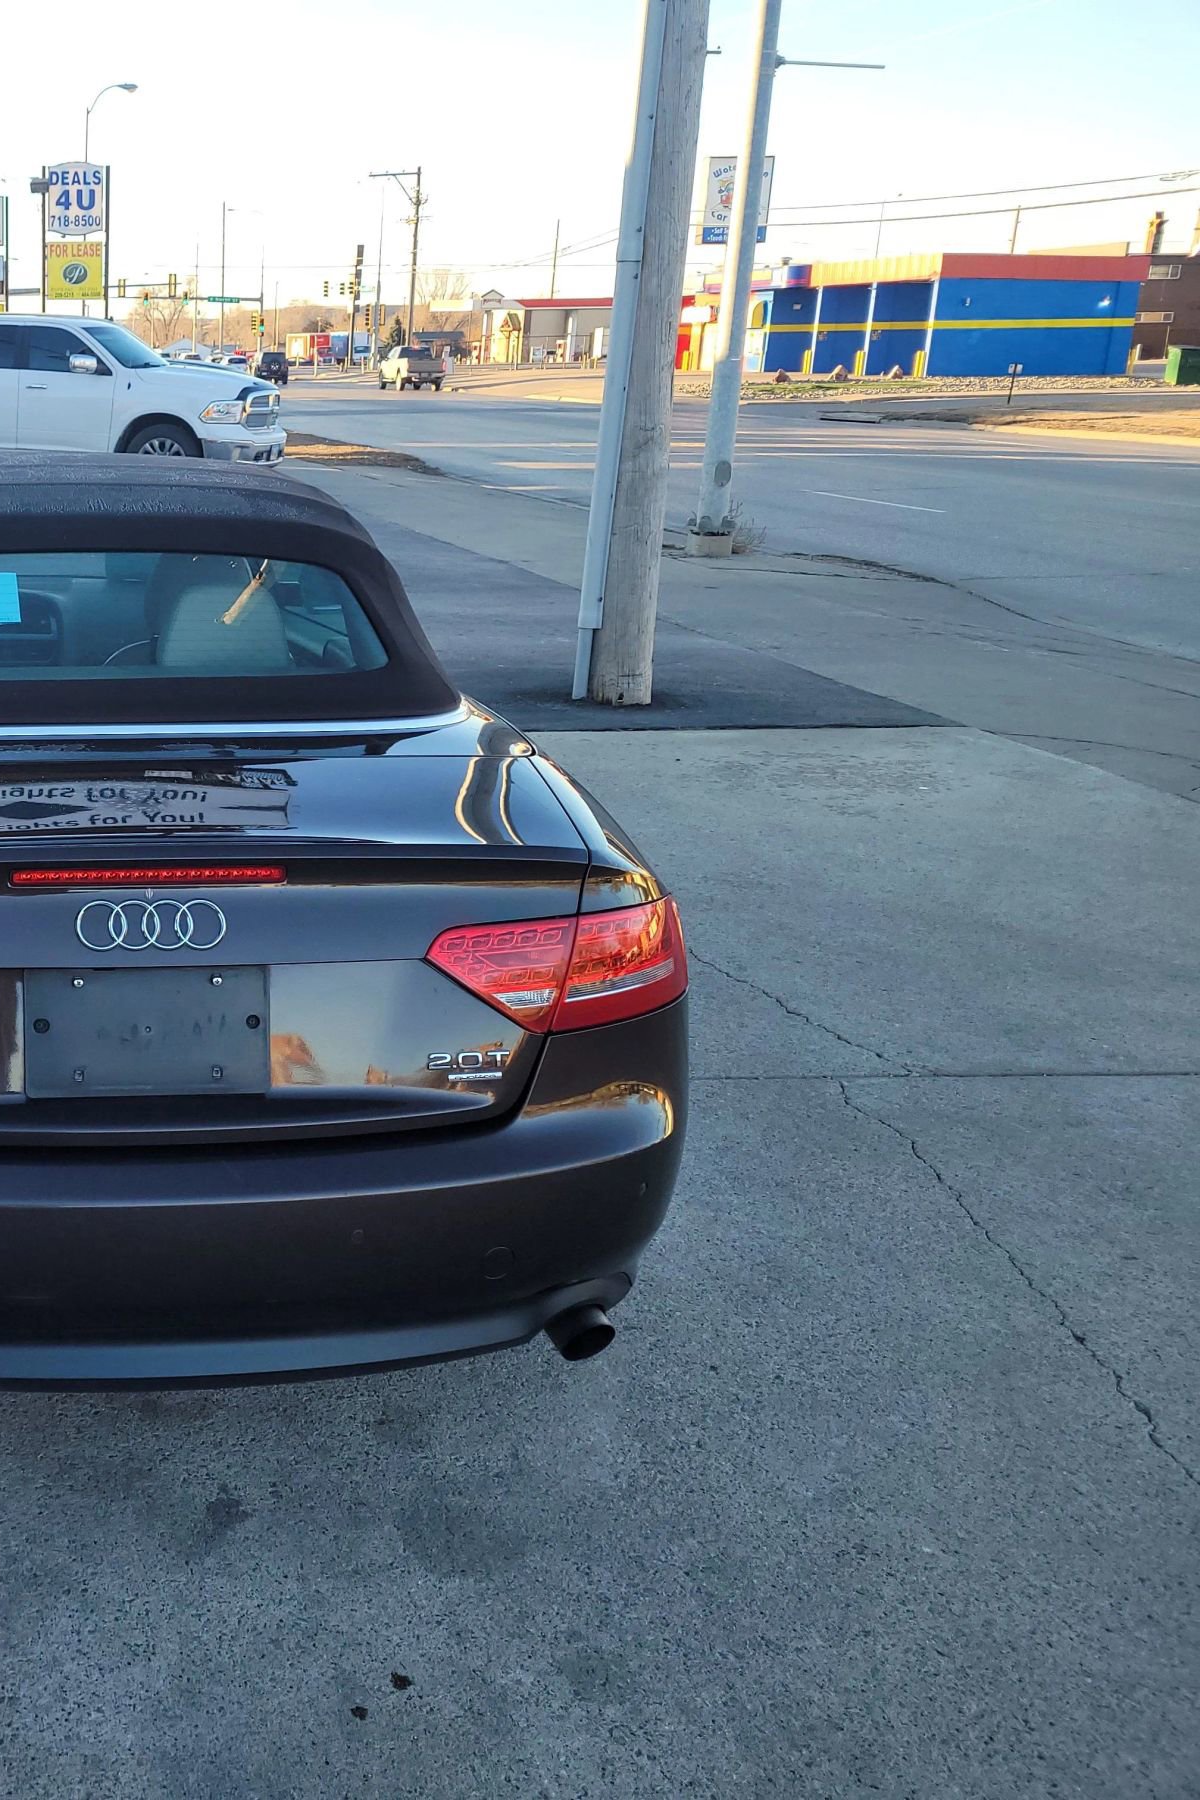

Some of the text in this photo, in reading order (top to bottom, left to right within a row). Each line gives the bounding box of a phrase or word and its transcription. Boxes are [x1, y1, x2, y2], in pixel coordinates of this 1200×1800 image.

[49, 170, 101, 186] DEALS
[49, 243, 101, 258] FOR LEASE
[427, 1050, 510, 1071] 2.0T
